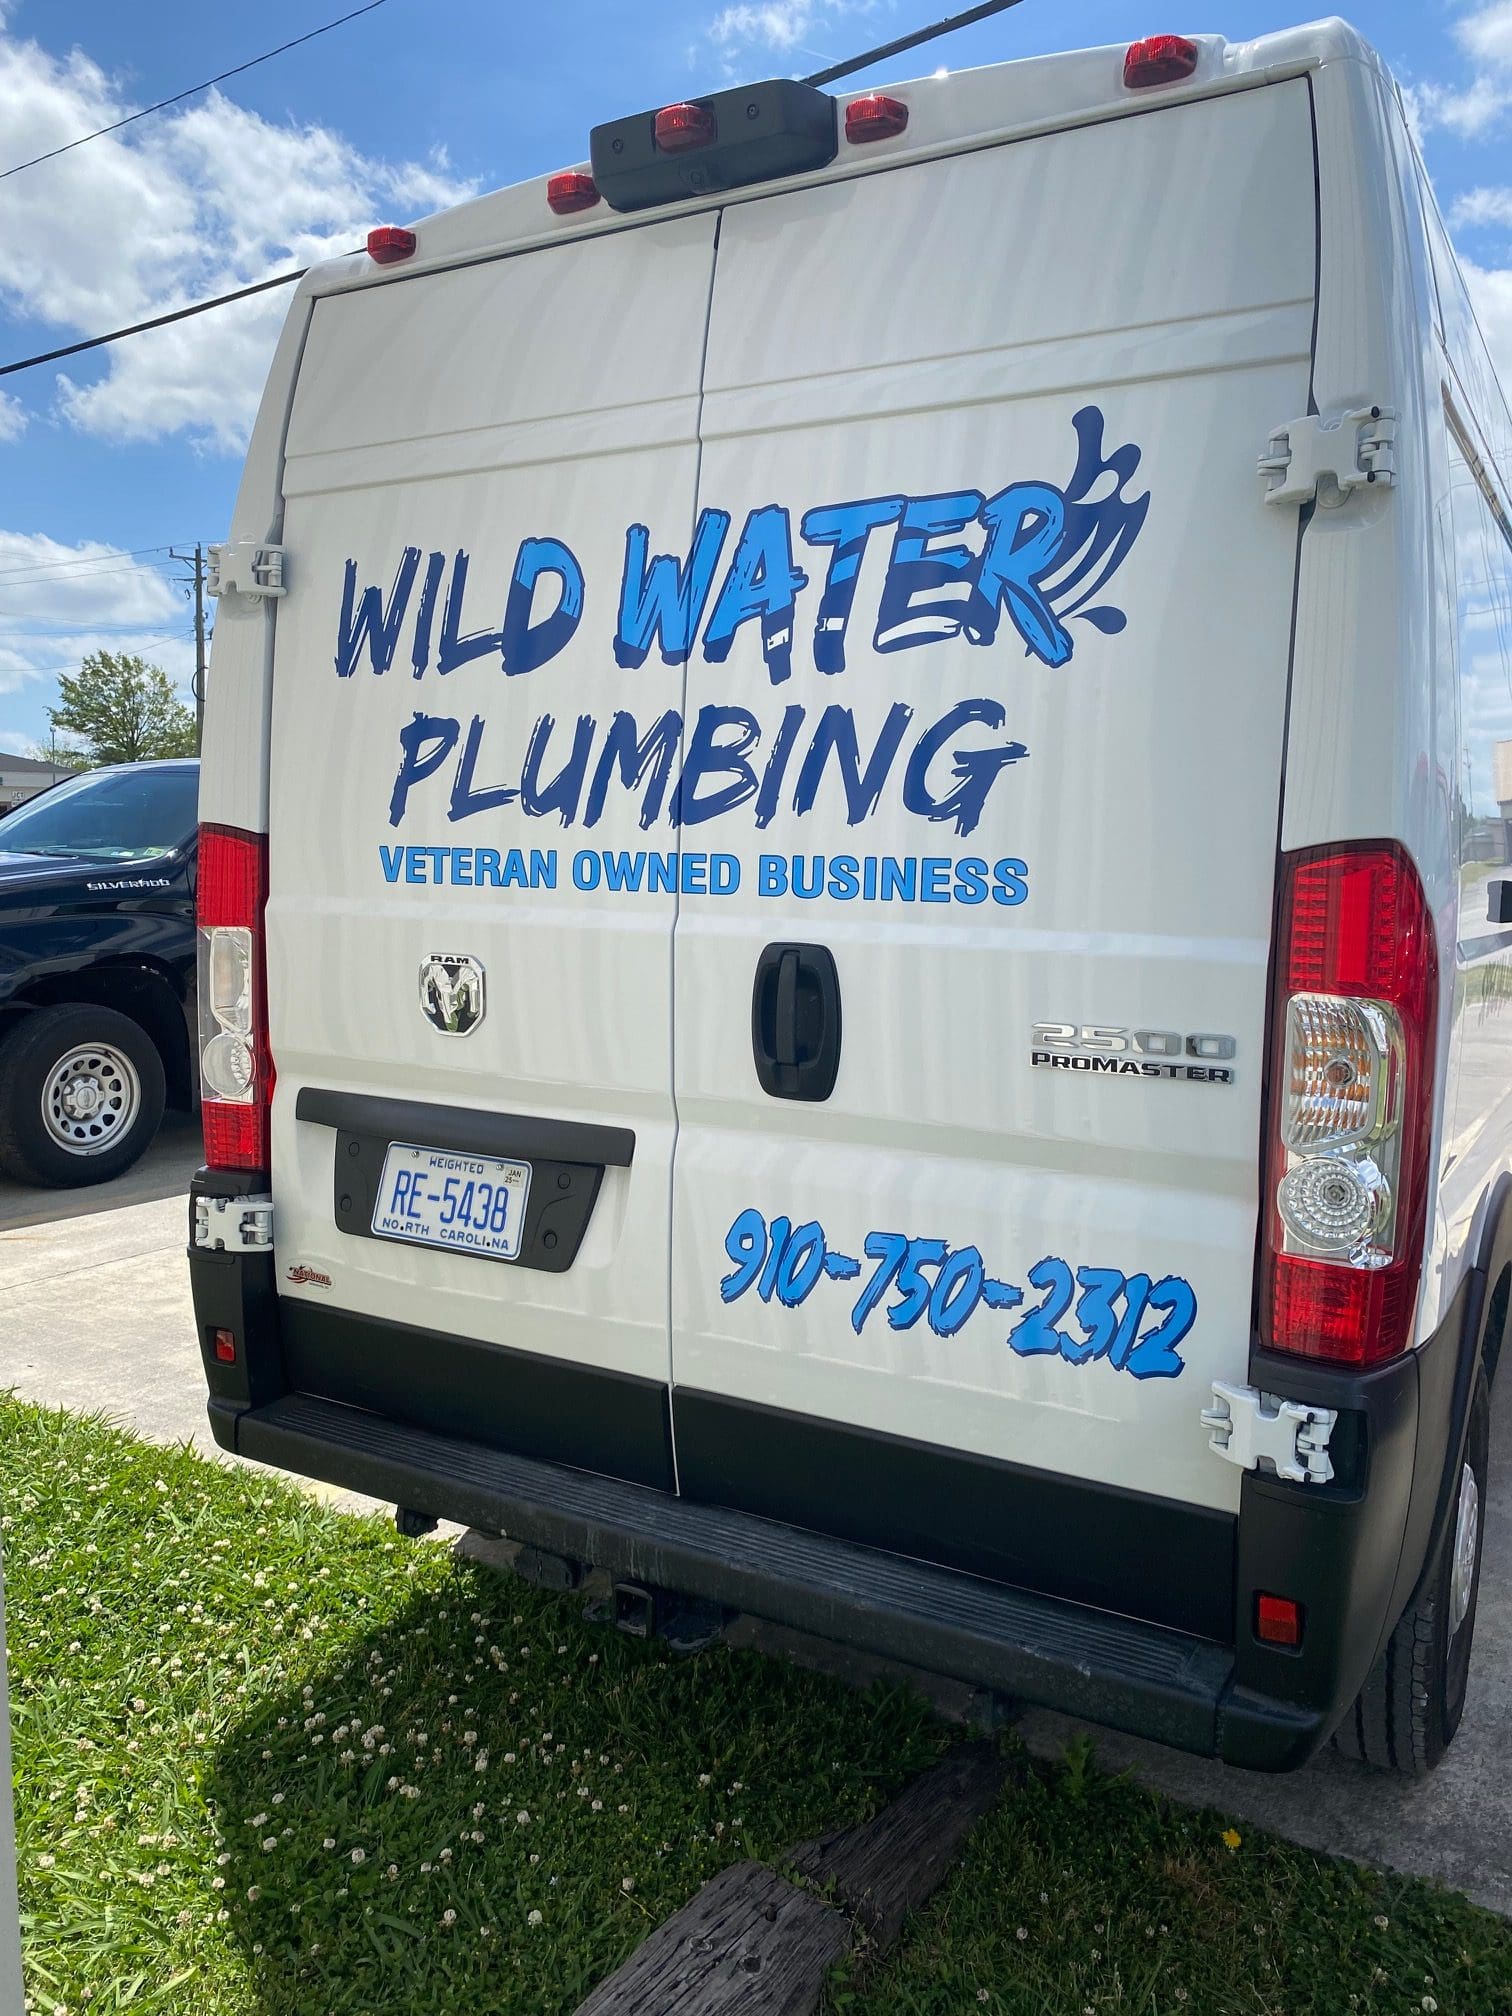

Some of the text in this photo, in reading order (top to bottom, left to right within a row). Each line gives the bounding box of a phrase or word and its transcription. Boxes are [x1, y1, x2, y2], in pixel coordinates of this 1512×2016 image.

[335, 480, 1075, 685] WILD WATER
[389, 698, 1030, 837] PLUMBING
[86, 878, 171, 891] SILVERADO
[379, 845, 1030, 906] VETERAN OWNED BUSINESS
[430, 955, 470, 965] RAM
[1031, 1021, 1237, 1060] 2500
[429, 1156, 484, 1175] WEIGHTED
[507, 1168, 522, 1178] JAN
[390, 1170, 509, 1233] RE-5438
[382, 1217, 509, 1251] NORTH CAROLINA
[720, 1208, 1198, 1381] 910-750-2312
